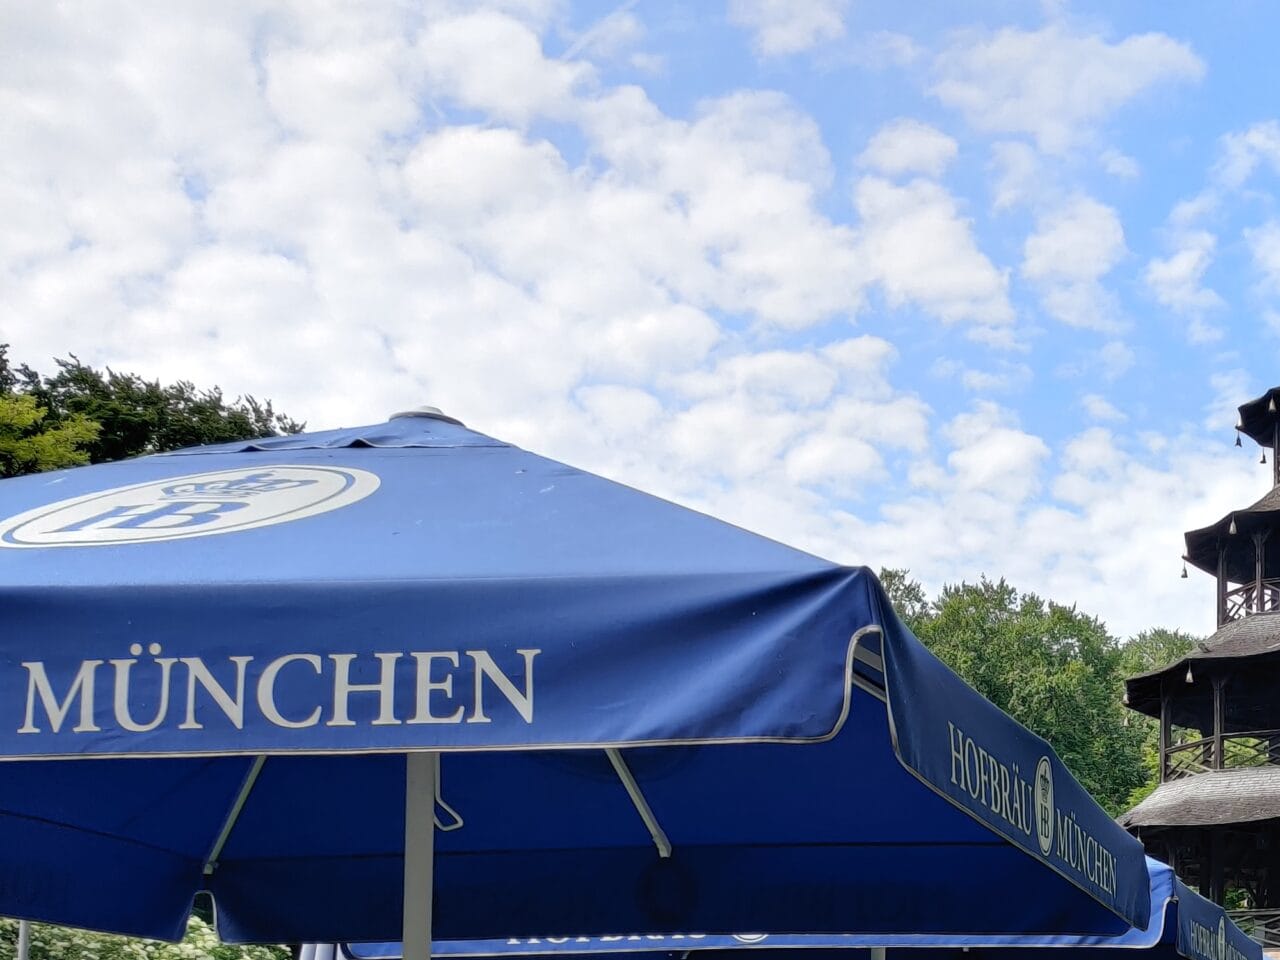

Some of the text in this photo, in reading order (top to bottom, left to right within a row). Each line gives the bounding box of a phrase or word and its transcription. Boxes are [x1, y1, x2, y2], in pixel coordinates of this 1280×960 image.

[17, 643, 542, 733] MÜNCHEN
[948, 721, 1032, 835] HOFBRÄU
[1057, 808, 1117, 898] MÜNCHEN
